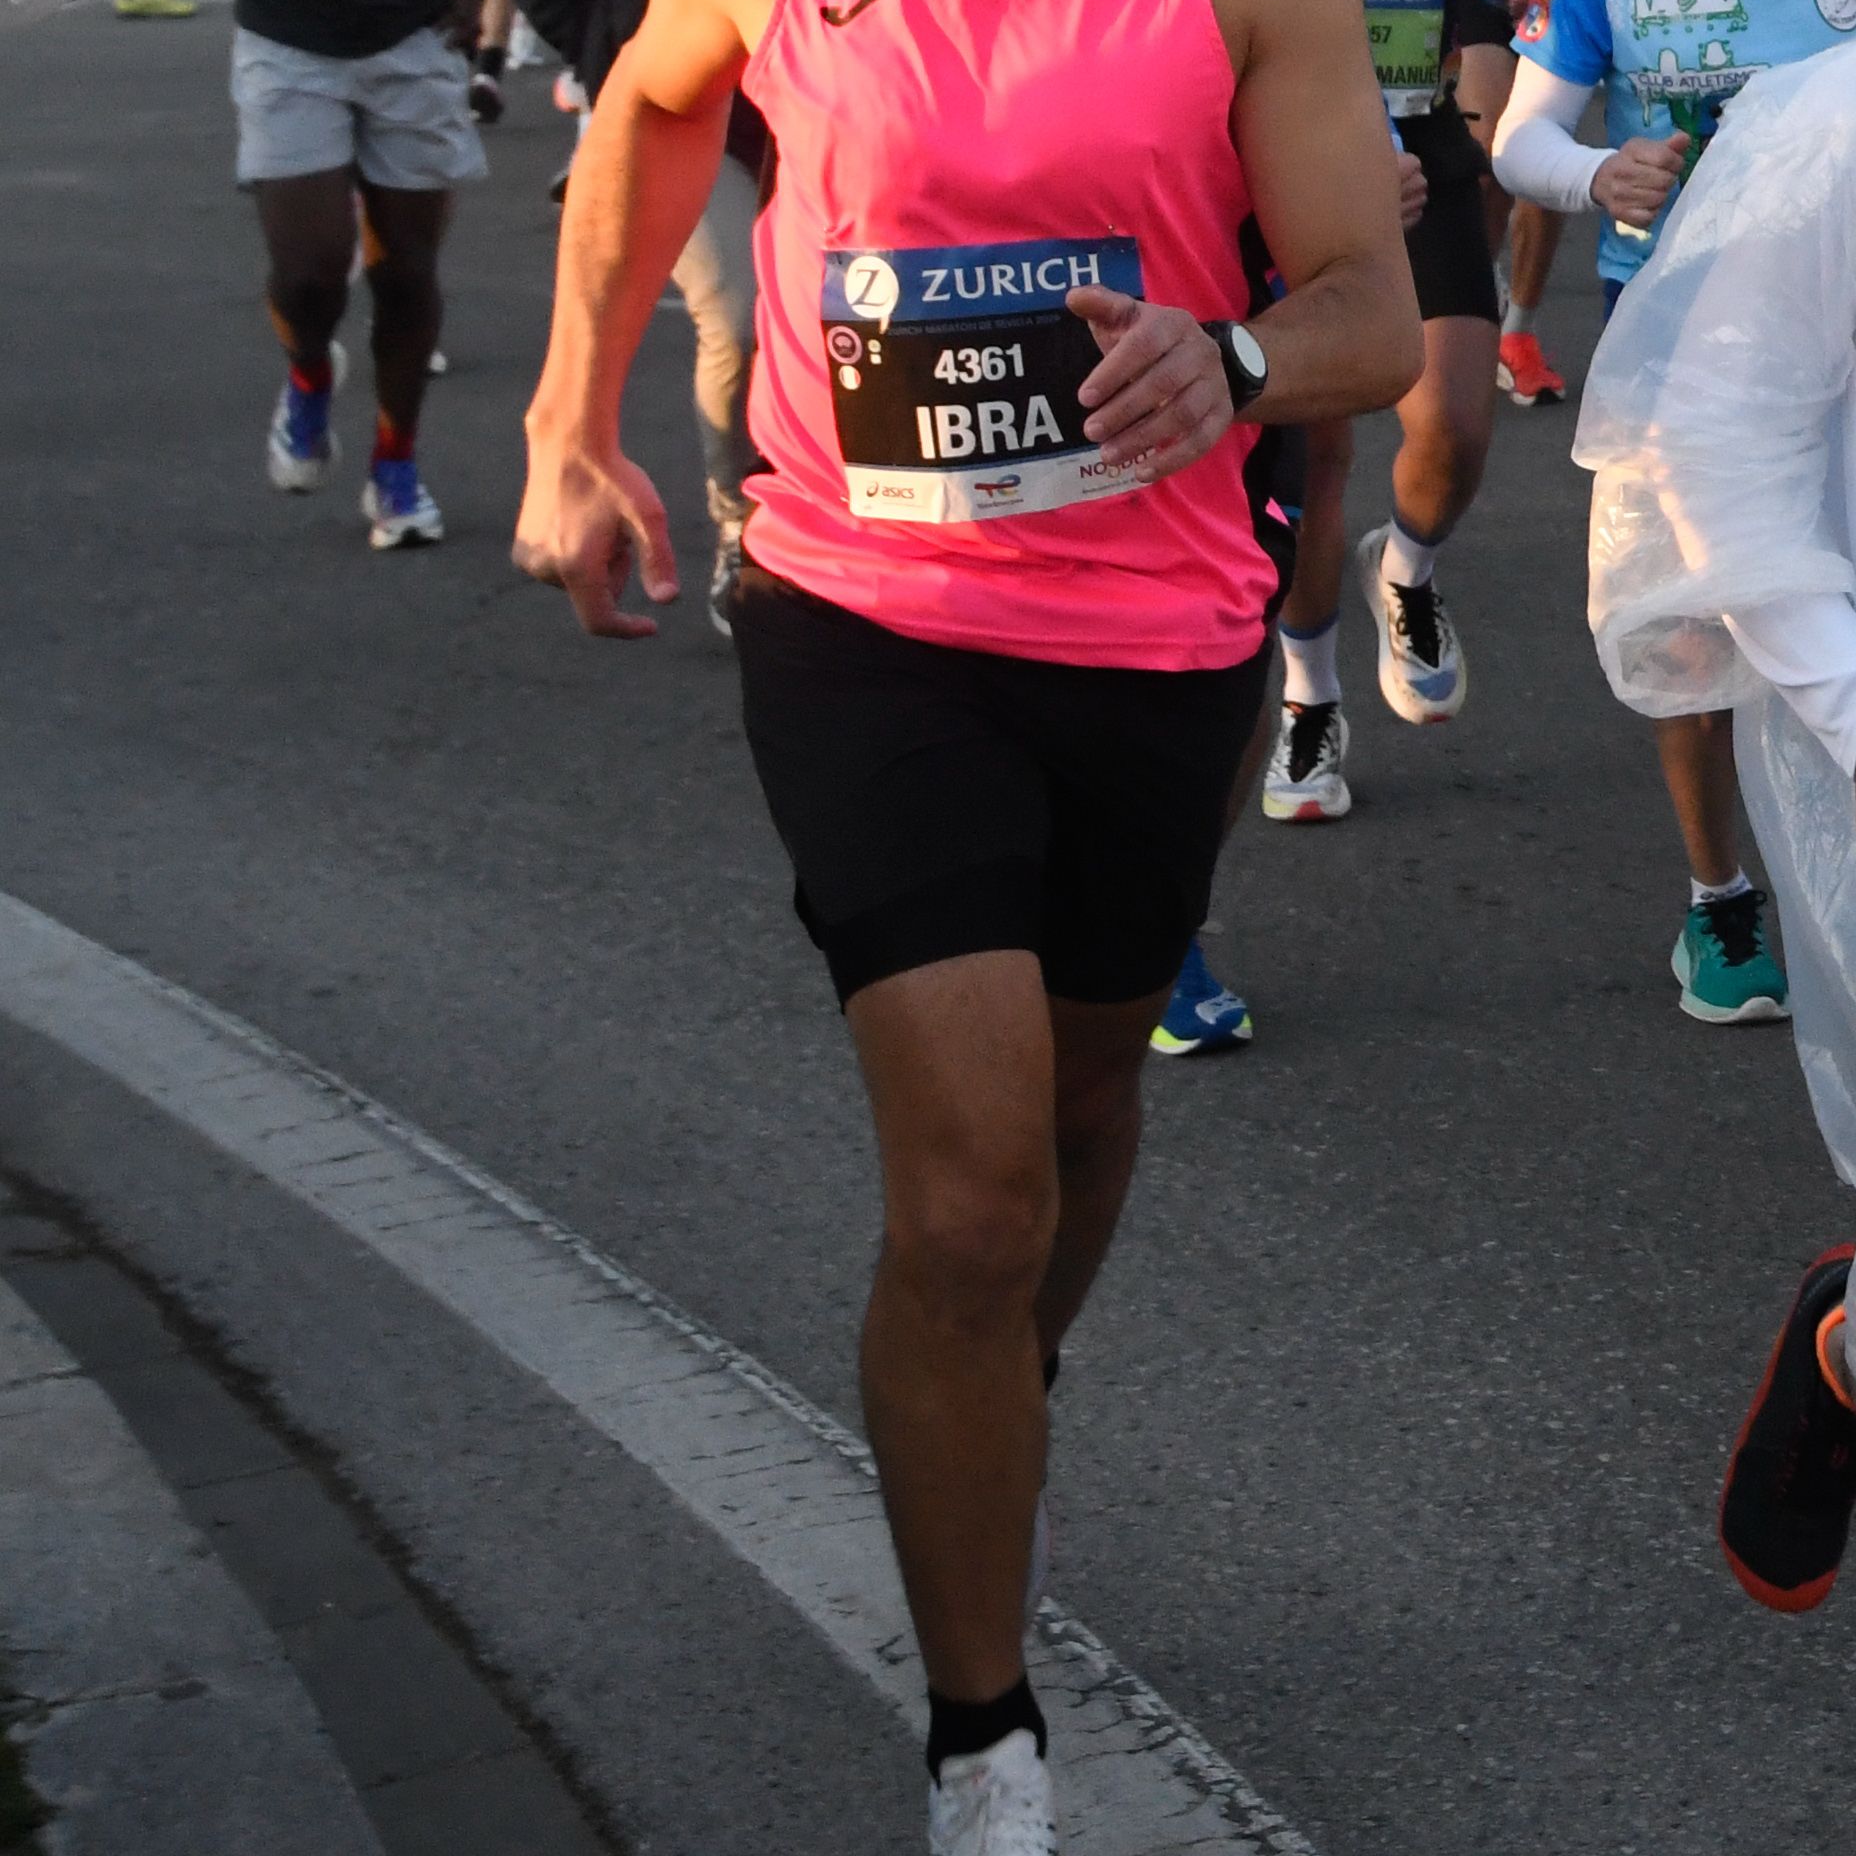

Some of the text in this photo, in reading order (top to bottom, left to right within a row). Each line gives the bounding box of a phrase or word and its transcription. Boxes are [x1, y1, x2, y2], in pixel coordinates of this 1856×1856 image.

[1638, 73, 1674, 87] CLUB
[921, 253, 1101, 303] ZURICH
[934, 343, 1025, 385] 4361
[916, 394, 1064, 460] IBRA
[882, 485, 915, 500] asics
